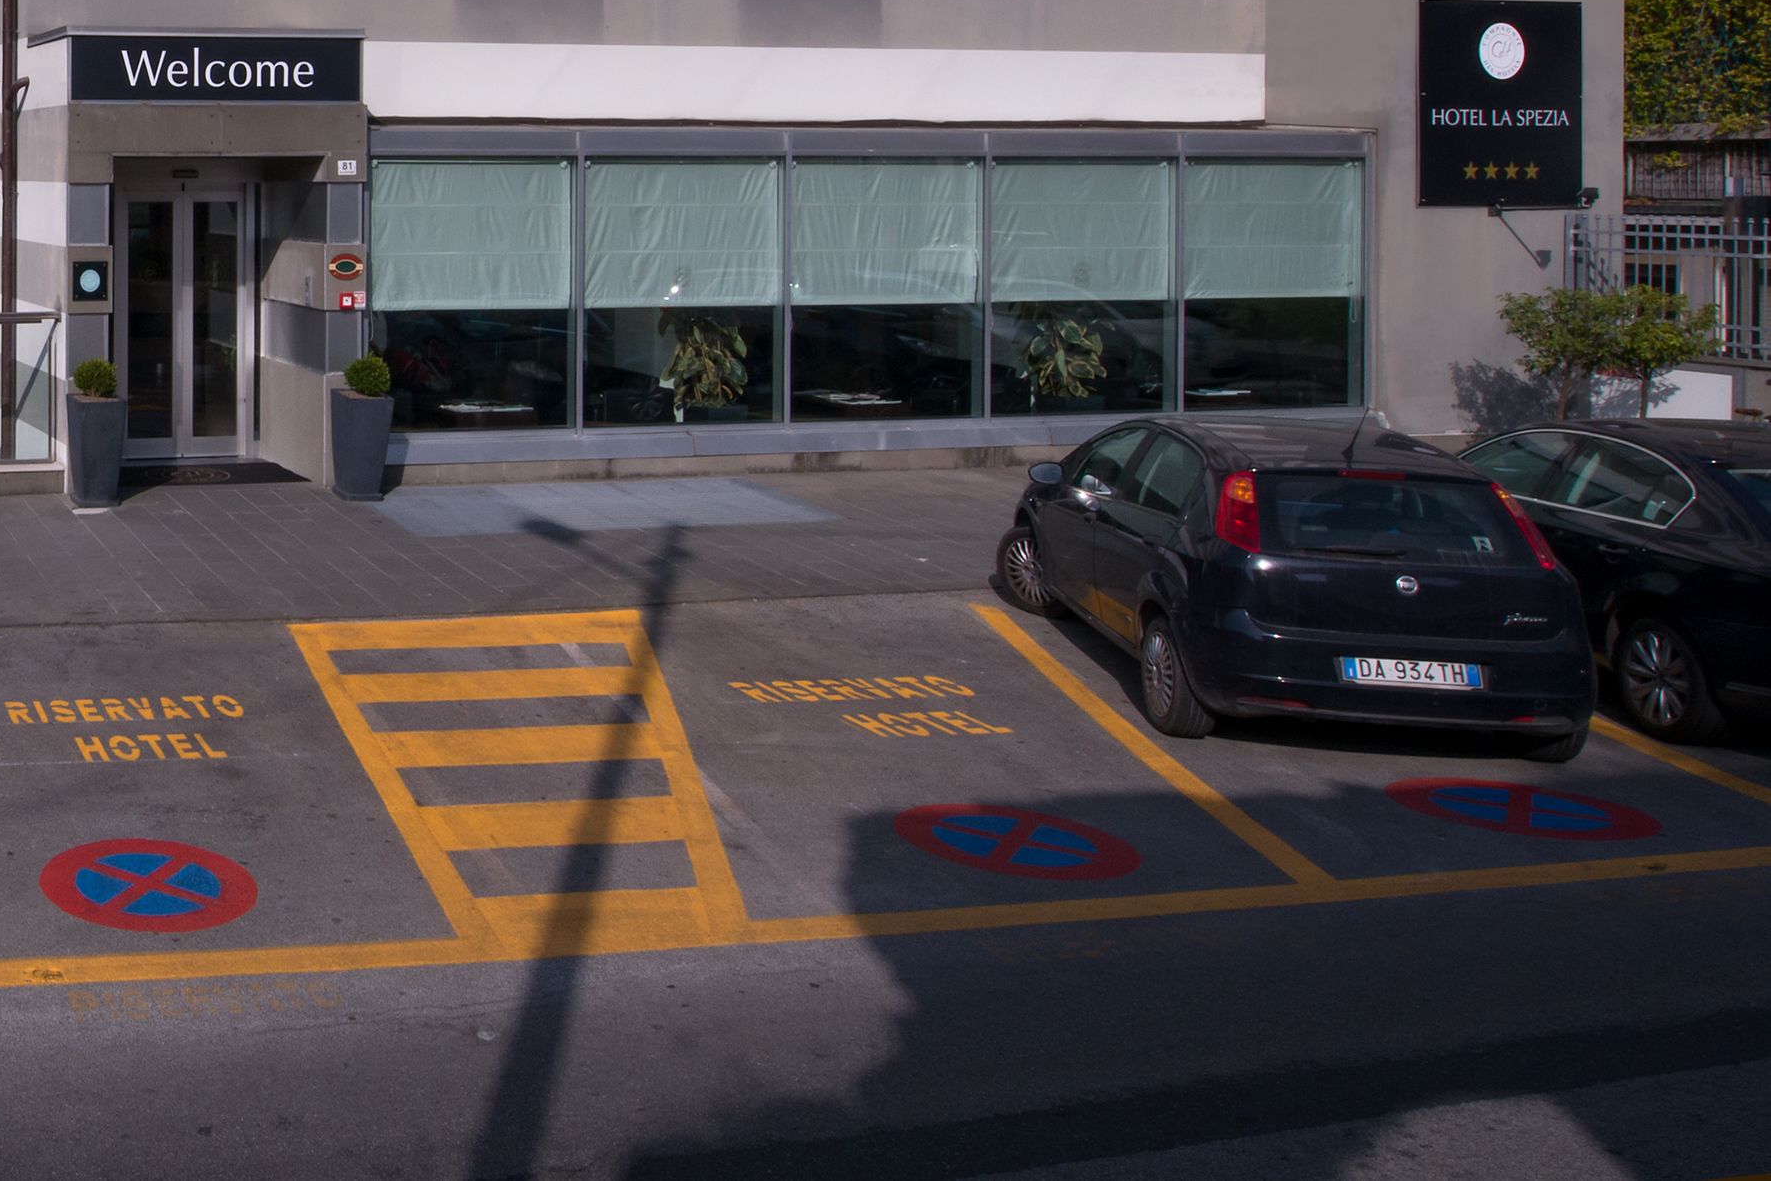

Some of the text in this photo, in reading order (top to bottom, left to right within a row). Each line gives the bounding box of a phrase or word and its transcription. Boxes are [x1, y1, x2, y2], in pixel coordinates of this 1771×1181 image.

[121, 47, 316, 88] Welcome
[1431, 108, 1569, 127] HOTEL LA SPEZIA
[342, 161, 353, 171] 81
[1358, 658, 1466, 684] DA 934TH
[4, 694, 245, 724] RISERVATO
[75, 732, 228, 762] HOTEL
